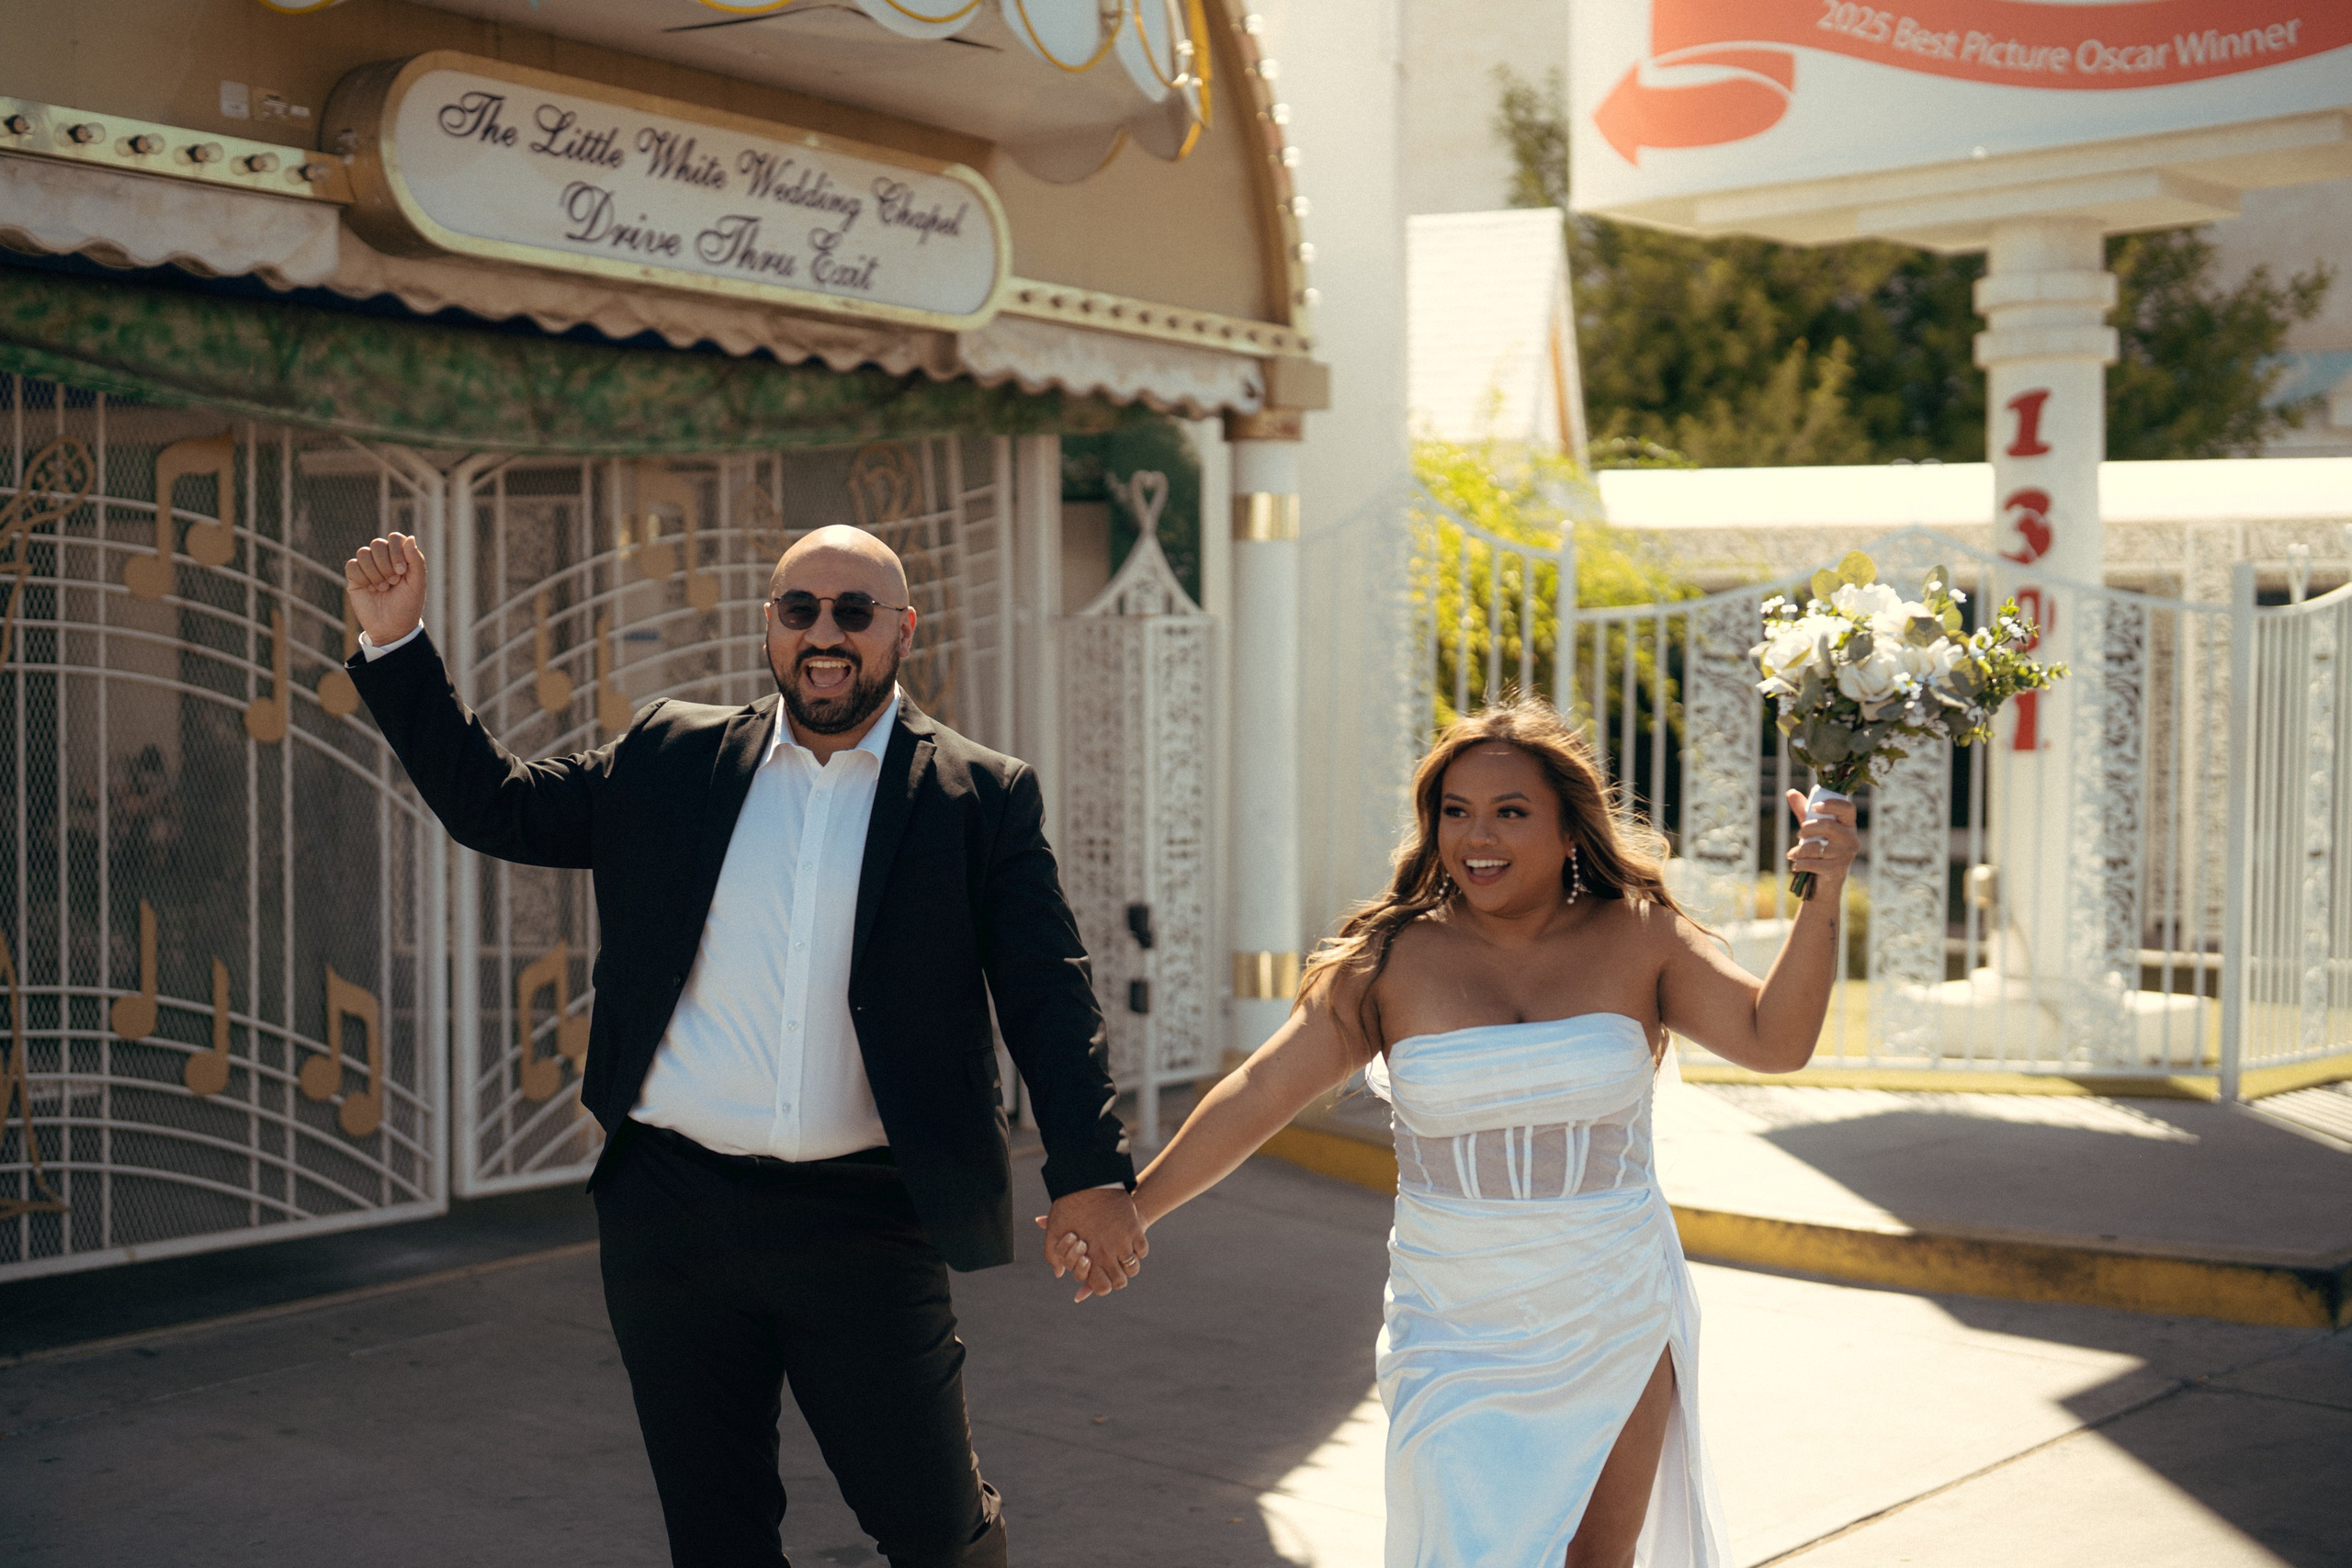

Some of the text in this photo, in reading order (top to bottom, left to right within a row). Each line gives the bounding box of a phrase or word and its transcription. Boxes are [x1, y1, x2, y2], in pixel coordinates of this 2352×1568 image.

[1816, 0, 2301, 74] 2025 Best Picture Oscar Winner
[438, 91, 970, 245] The Little White Wedding Chapel
[560, 180, 880, 290] Drive Thru Exit
